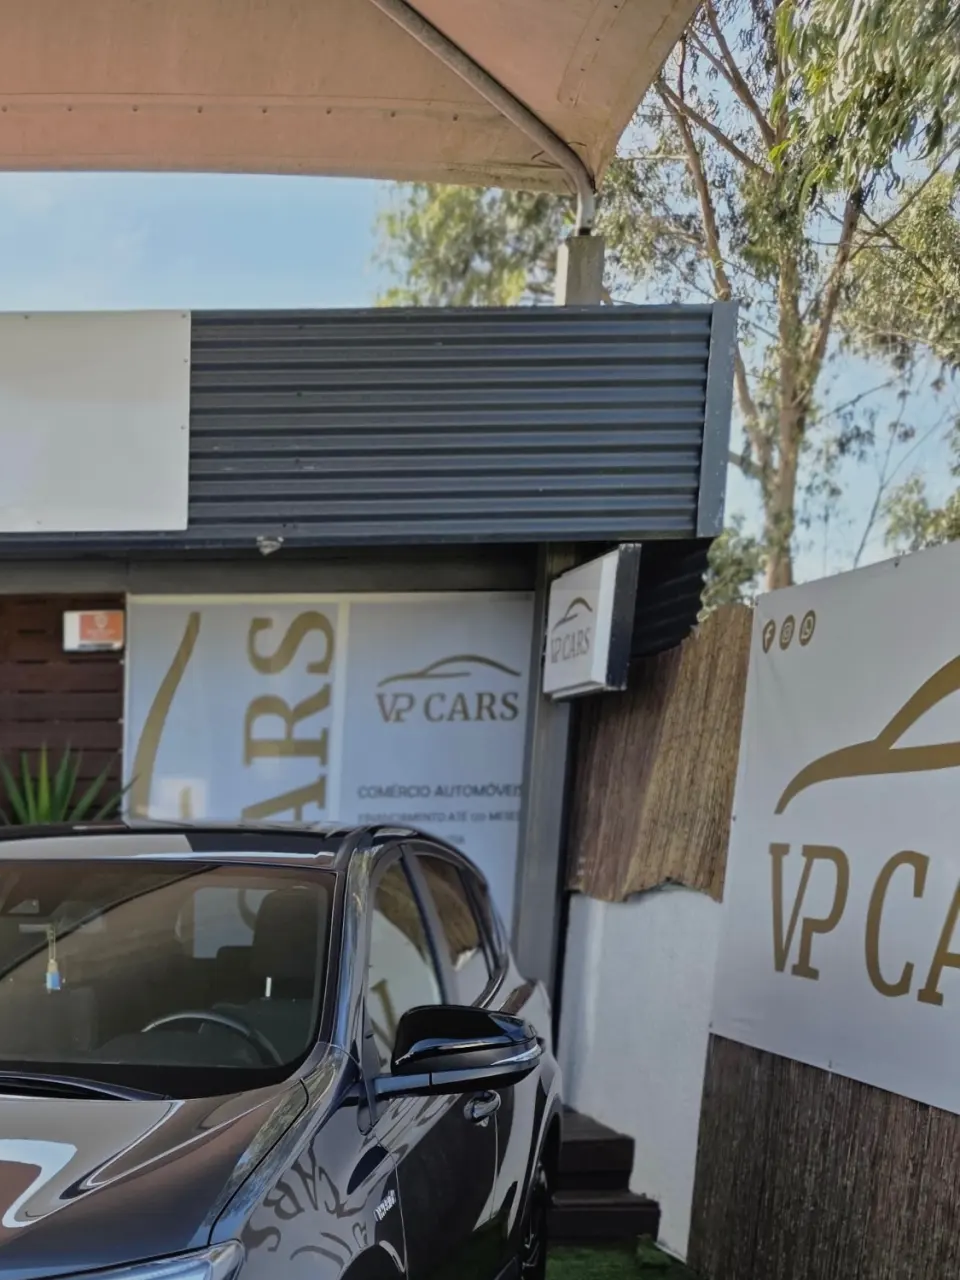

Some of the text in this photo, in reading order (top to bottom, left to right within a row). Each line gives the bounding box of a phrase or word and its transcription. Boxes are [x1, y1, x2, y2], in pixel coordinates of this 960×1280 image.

[375, 691, 520, 723] VP CARS
[357, 783, 432, 799] COMÉRCIO
[768, 842, 850, 982] VP
